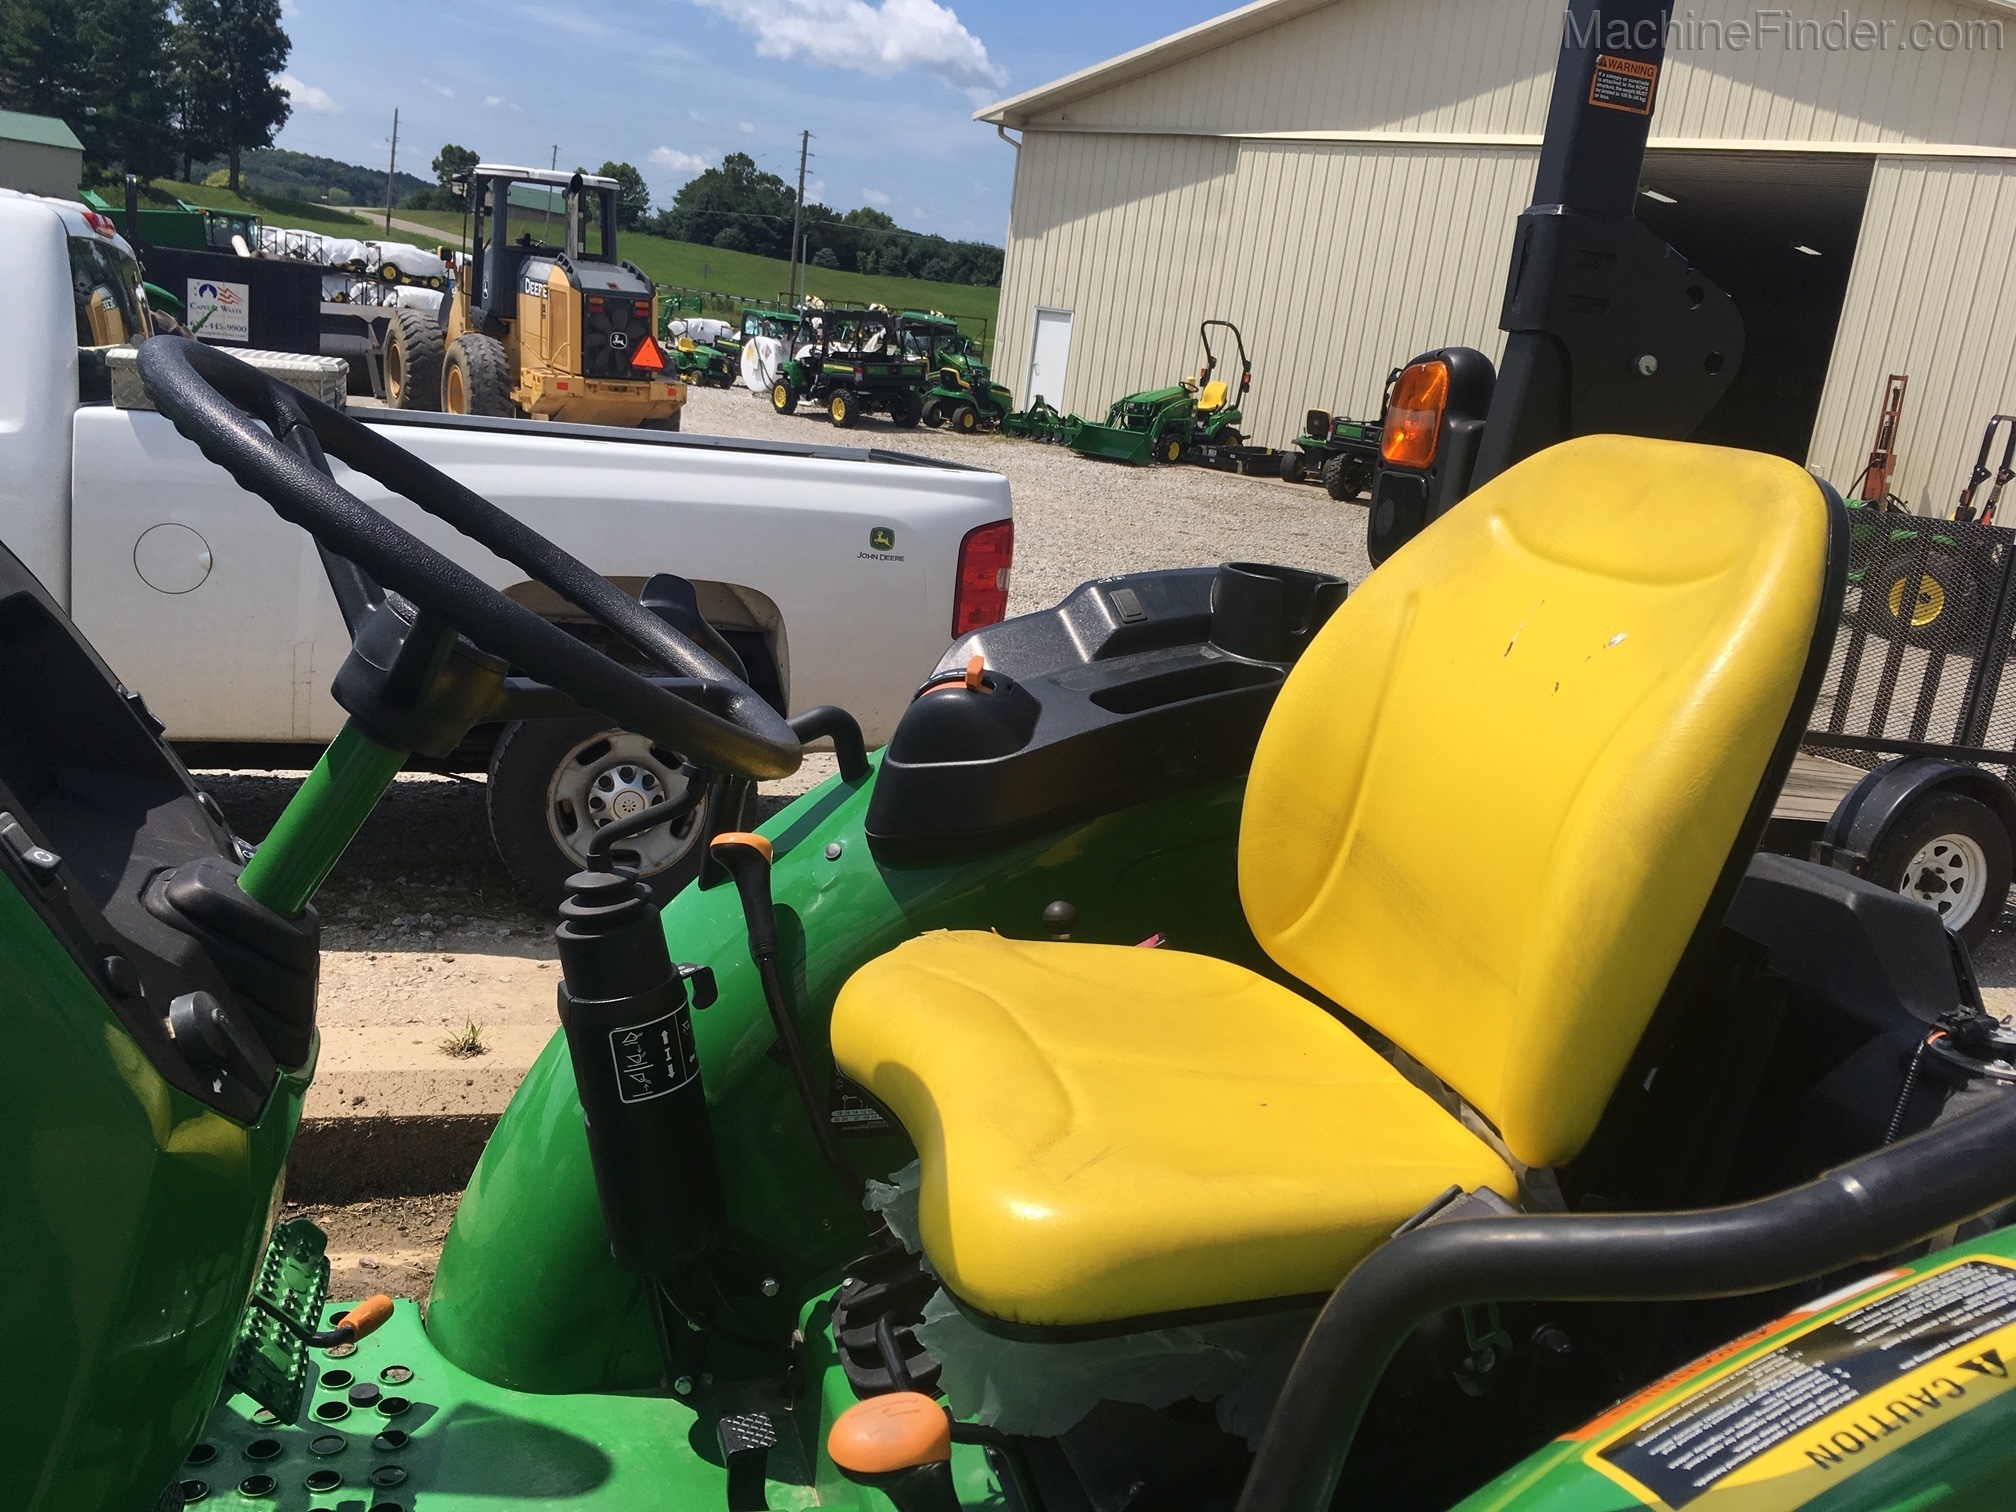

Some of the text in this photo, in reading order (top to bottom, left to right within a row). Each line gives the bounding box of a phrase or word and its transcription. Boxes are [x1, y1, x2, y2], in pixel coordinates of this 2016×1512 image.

[1608, 59, 1655, 77] WARNING
[525, 277, 548, 298] DEERE
[220, 305, 242, 314] WASTE
[857, 552, 905, 562] JOHN DEERE
[1805, 1377, 1966, 1470] CAUTION
